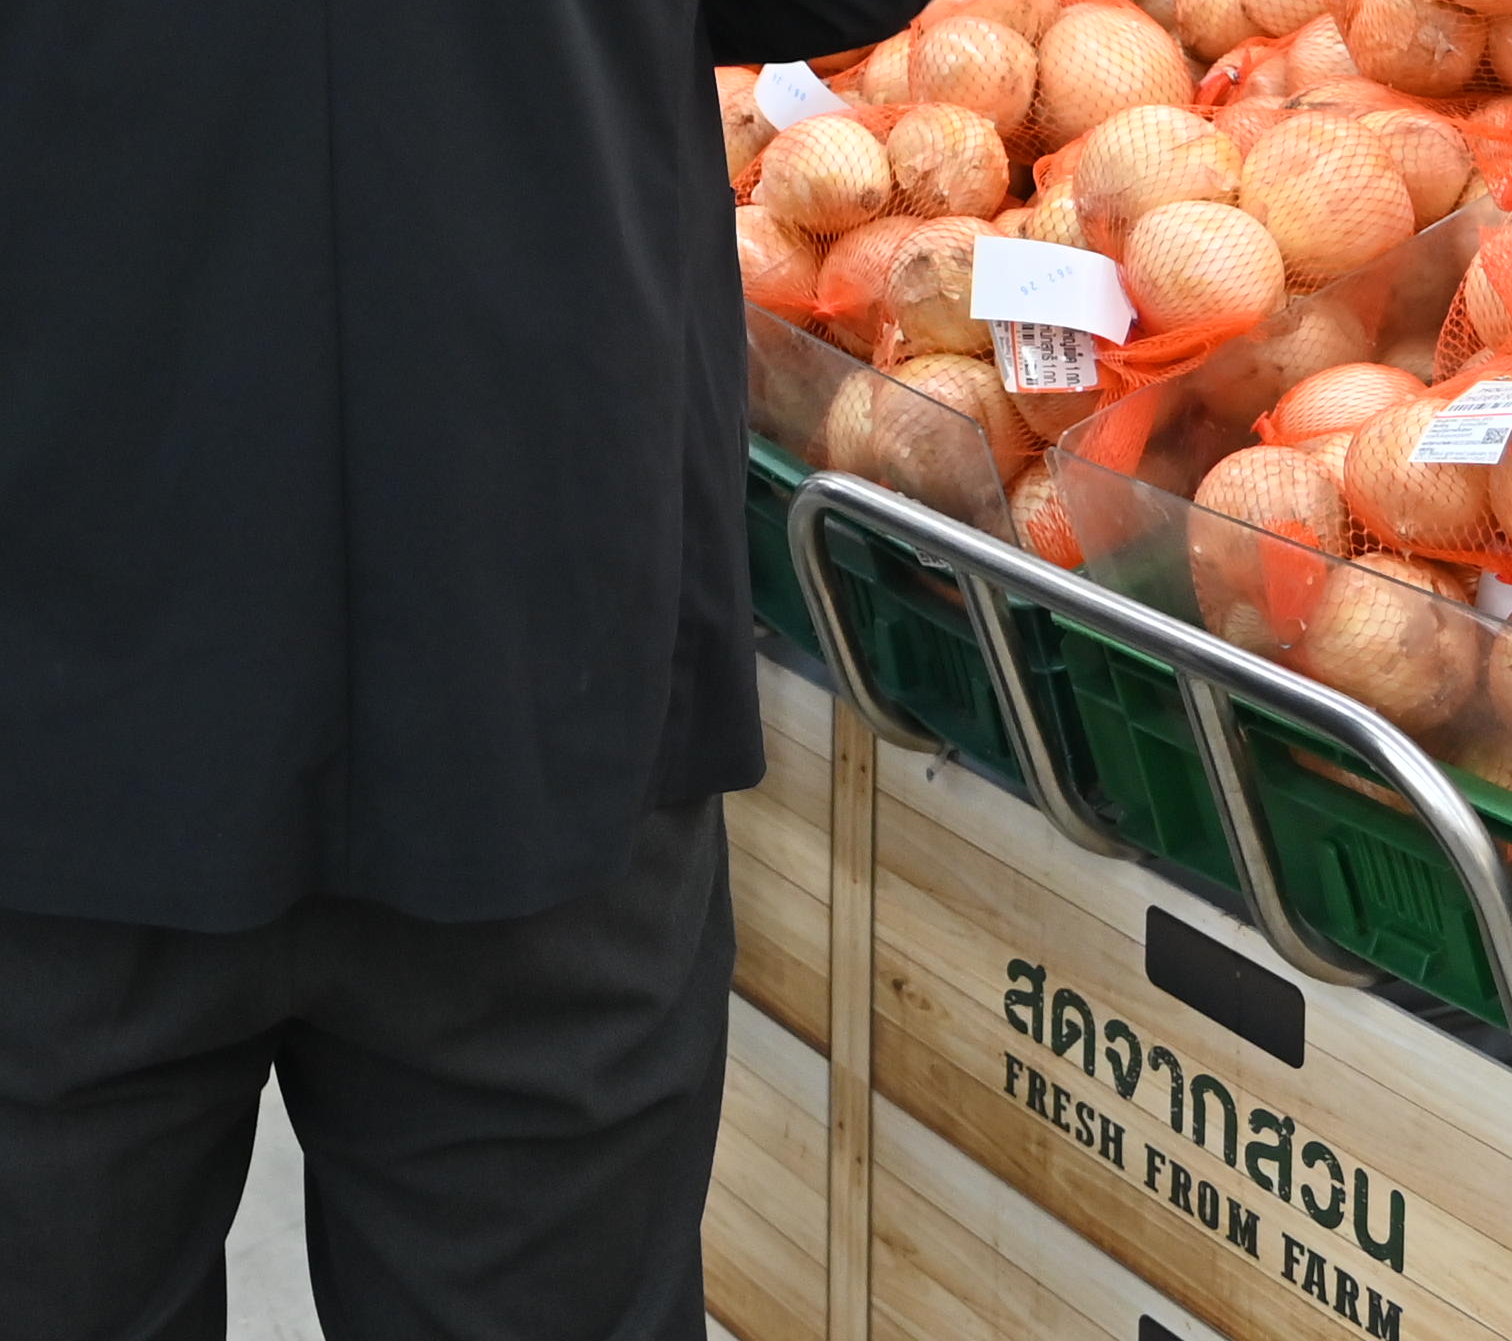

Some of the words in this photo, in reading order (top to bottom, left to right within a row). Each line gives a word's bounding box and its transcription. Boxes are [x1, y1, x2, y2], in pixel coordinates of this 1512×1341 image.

[1003, 1050, 1126, 1171] FRESH
[1143, 1142, 1262, 1260] FROM
[1280, 1231, 1404, 1341] FARM
[1004, 958, 1406, 1274] สดจากสวน
